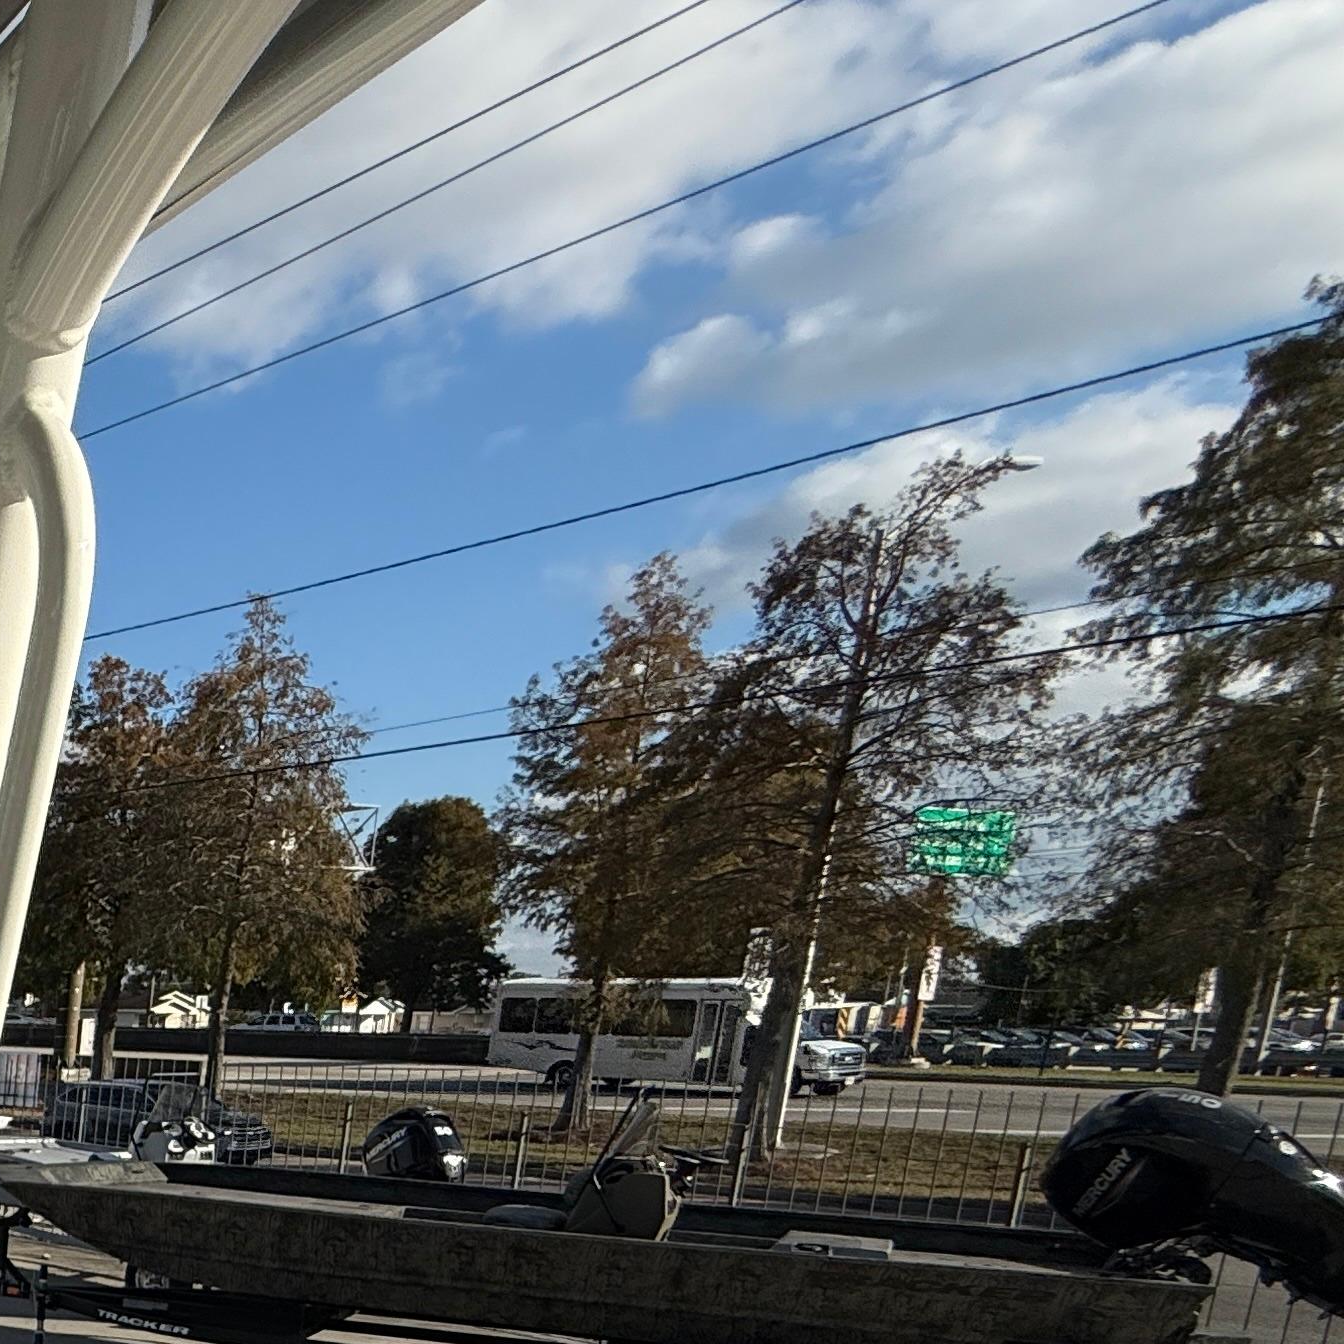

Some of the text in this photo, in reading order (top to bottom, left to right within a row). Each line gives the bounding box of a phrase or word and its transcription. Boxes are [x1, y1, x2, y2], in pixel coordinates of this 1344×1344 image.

[1158, 1092, 1223, 1109] 150
[366, 1126, 408, 1161] MERCURY
[1072, 1147, 1133, 1217] MERCURY
[96, 1308, 191, 1336] TRACKER
